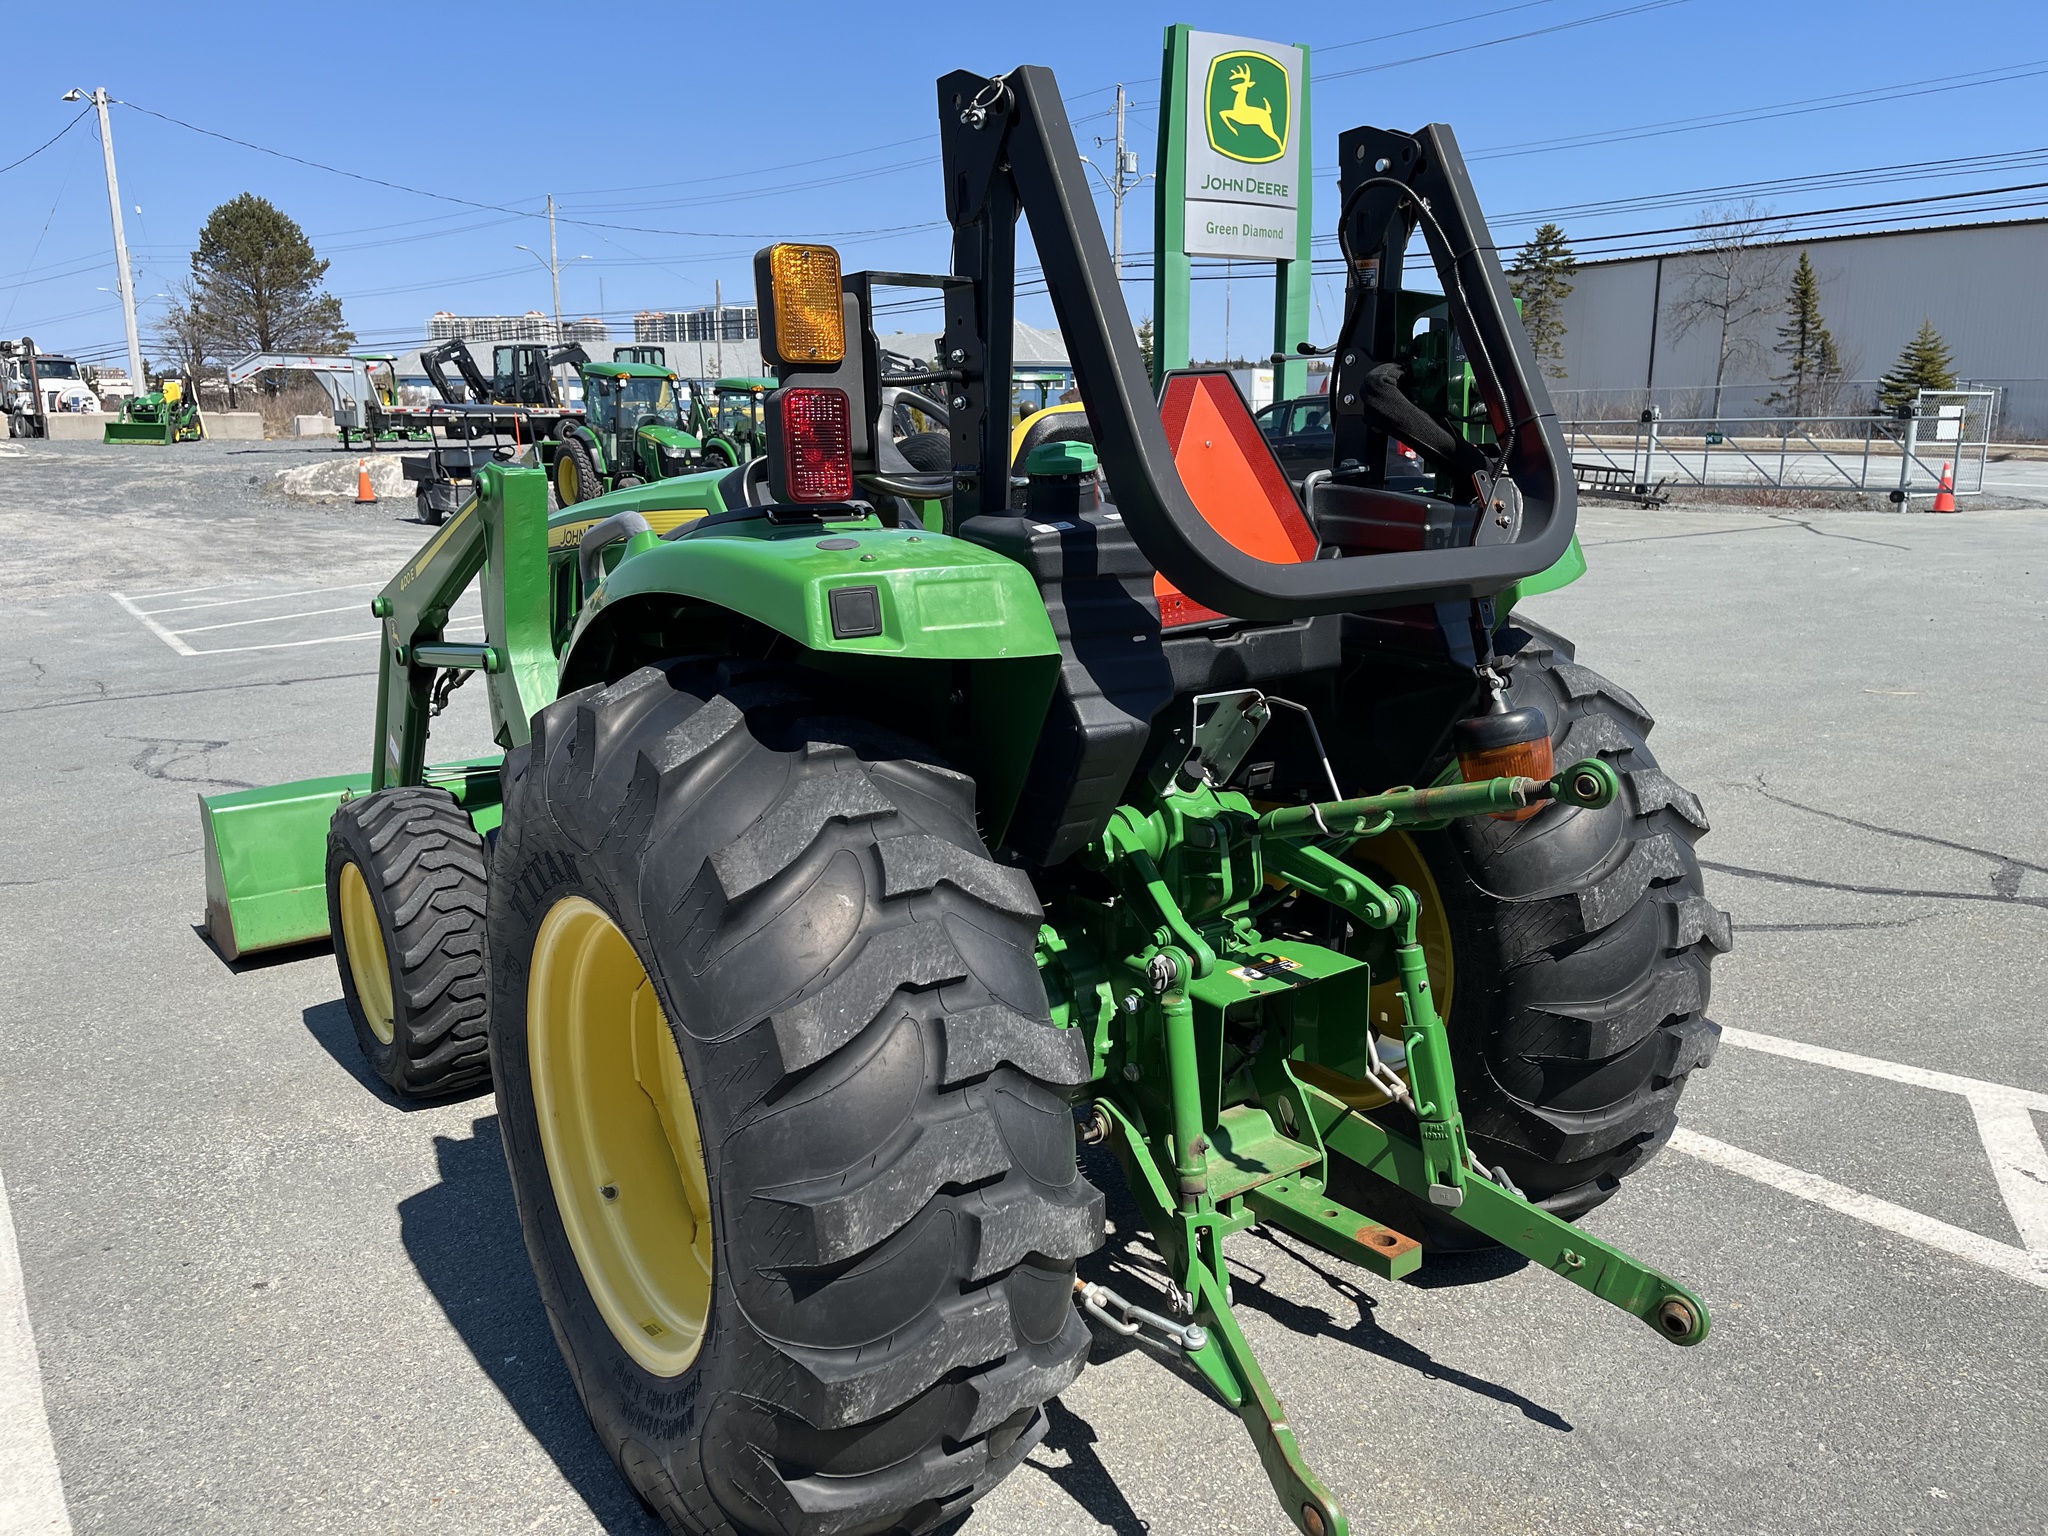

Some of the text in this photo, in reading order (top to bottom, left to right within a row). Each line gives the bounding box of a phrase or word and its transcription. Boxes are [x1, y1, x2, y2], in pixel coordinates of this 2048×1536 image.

[1201, 174, 1289, 197] JOHN DEERE
[1206, 221, 1284, 239] Green Diamond
[508, 850, 584, 931] TITAN
